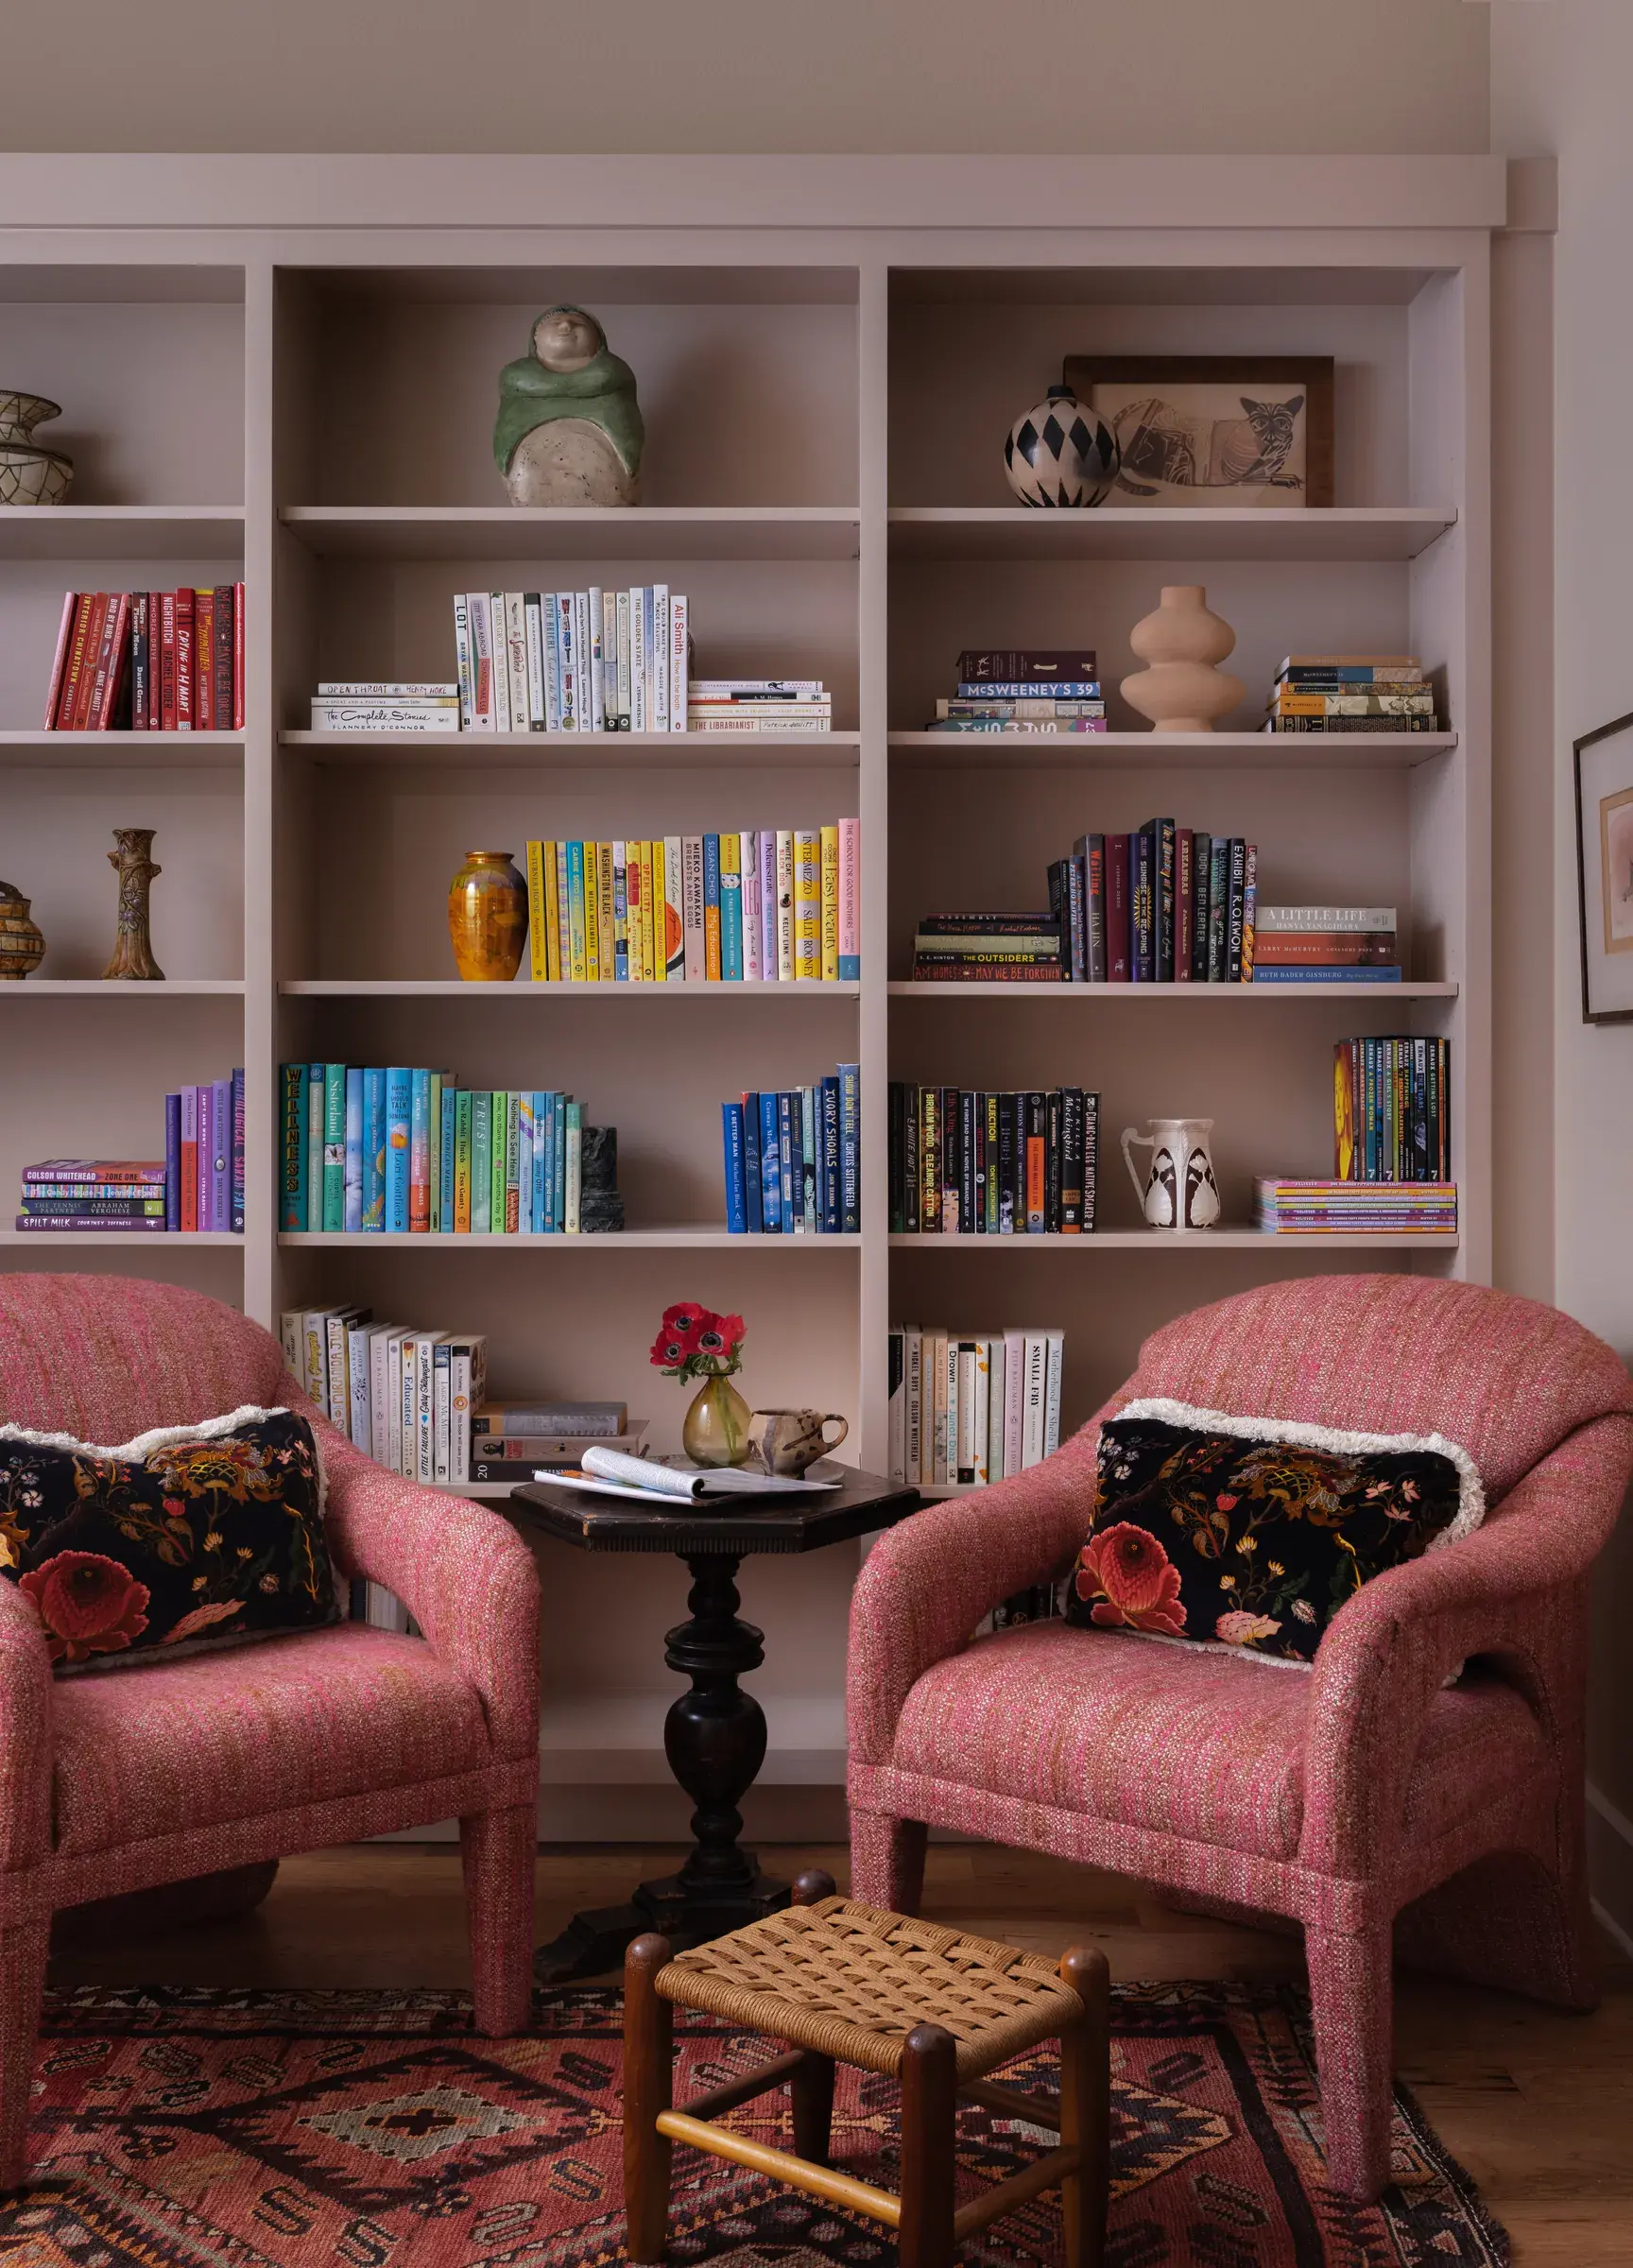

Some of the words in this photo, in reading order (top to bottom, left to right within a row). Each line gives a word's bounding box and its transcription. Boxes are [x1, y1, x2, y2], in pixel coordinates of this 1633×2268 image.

[79, 596, 91, 633] INTERIOR
[163, 597, 173, 644] NIGHTBITCH
[456, 606, 466, 630] LOT
[675, 605, 683, 618] Ali
[105, 625, 113, 639] BIRD
[179, 630, 189, 662] CRYING
[675, 622, 683, 654] Smith
[71, 637, 83, 682] CHINATOWN
[198, 623, 210, 671] SYMPATHIZER
[96, 670, 105, 686] ANNE
[163, 651, 172, 679] RACHEL
[180, 675, 189, 684] H
[354, 685, 387, 694] THROAT
[675, 684, 680, 694] be
[1076, 684, 1093, 696] 39
[93, 688, 103, 712] LAMOTT
[163, 684, 172, 708] YODER
[179, 685, 189, 713] MART
[324, 709, 337, 721] The
[340, 710, 387, 725] Complete
[388, 711, 431, 722] Stories
[696, 721, 706, 730] THE
[710, 721, 755, 730] LIBRARIANIST
[602, 848, 610, 891] WASHINGTON
[802, 836, 812, 895] INTERMEZZO
[1090, 850, 1100, 895] Waiting
[1233, 846, 1243, 885] EXHIBIT
[823, 868, 836, 900] Easy
[602, 894, 610, 916] BLACK
[1267, 911, 1275, 919] A
[1281, 910, 1332, 921] LITTLE
[1336, 910, 1367, 921] LIFE
[708, 915, 717, 928] My
[804, 910, 813, 937] SALLY
[824, 903, 836, 952] Beauty
[1231, 921, 1241, 953] KWON
[804, 940, 813, 978] ROONEY
[845, 1074, 854, 1095] SHOW
[234, 1077, 244, 1147] PATHOLOGICAL
[329, 1080, 341, 1136] Sisterland
[826, 1089, 835, 1125] IVORY
[845, 1097, 854, 1116] DON'T
[1074, 1098, 1081, 1111] TO
[476, 1100, 486, 1151] TRUST
[1062, 1096, 1074, 1160] Mockingbird
[827, 1128, 836, 1167] SHOALS
[846, 1143, 854, 1166] CURTIS
[57, 1172, 96, 1180] WHITEHEAD
[234, 1157, 244, 1188] SARAH
[395, 1153, 404, 1174] Lori
[234, 1192, 244, 1210] FAY
[394, 1177, 404, 1216] Gottlieb
[846, 1168, 854, 1207] SITTENFELD
[24, 1218, 46, 1227] SPILT
[1031, 1346, 1040, 1383] SMALL
[1050, 1350, 1058, 1401] Motherhood
[404, 1376, 412, 1426] Educated
[1031, 1387, 1040, 1407] FRY
[478, 1465, 488, 1479] 20
